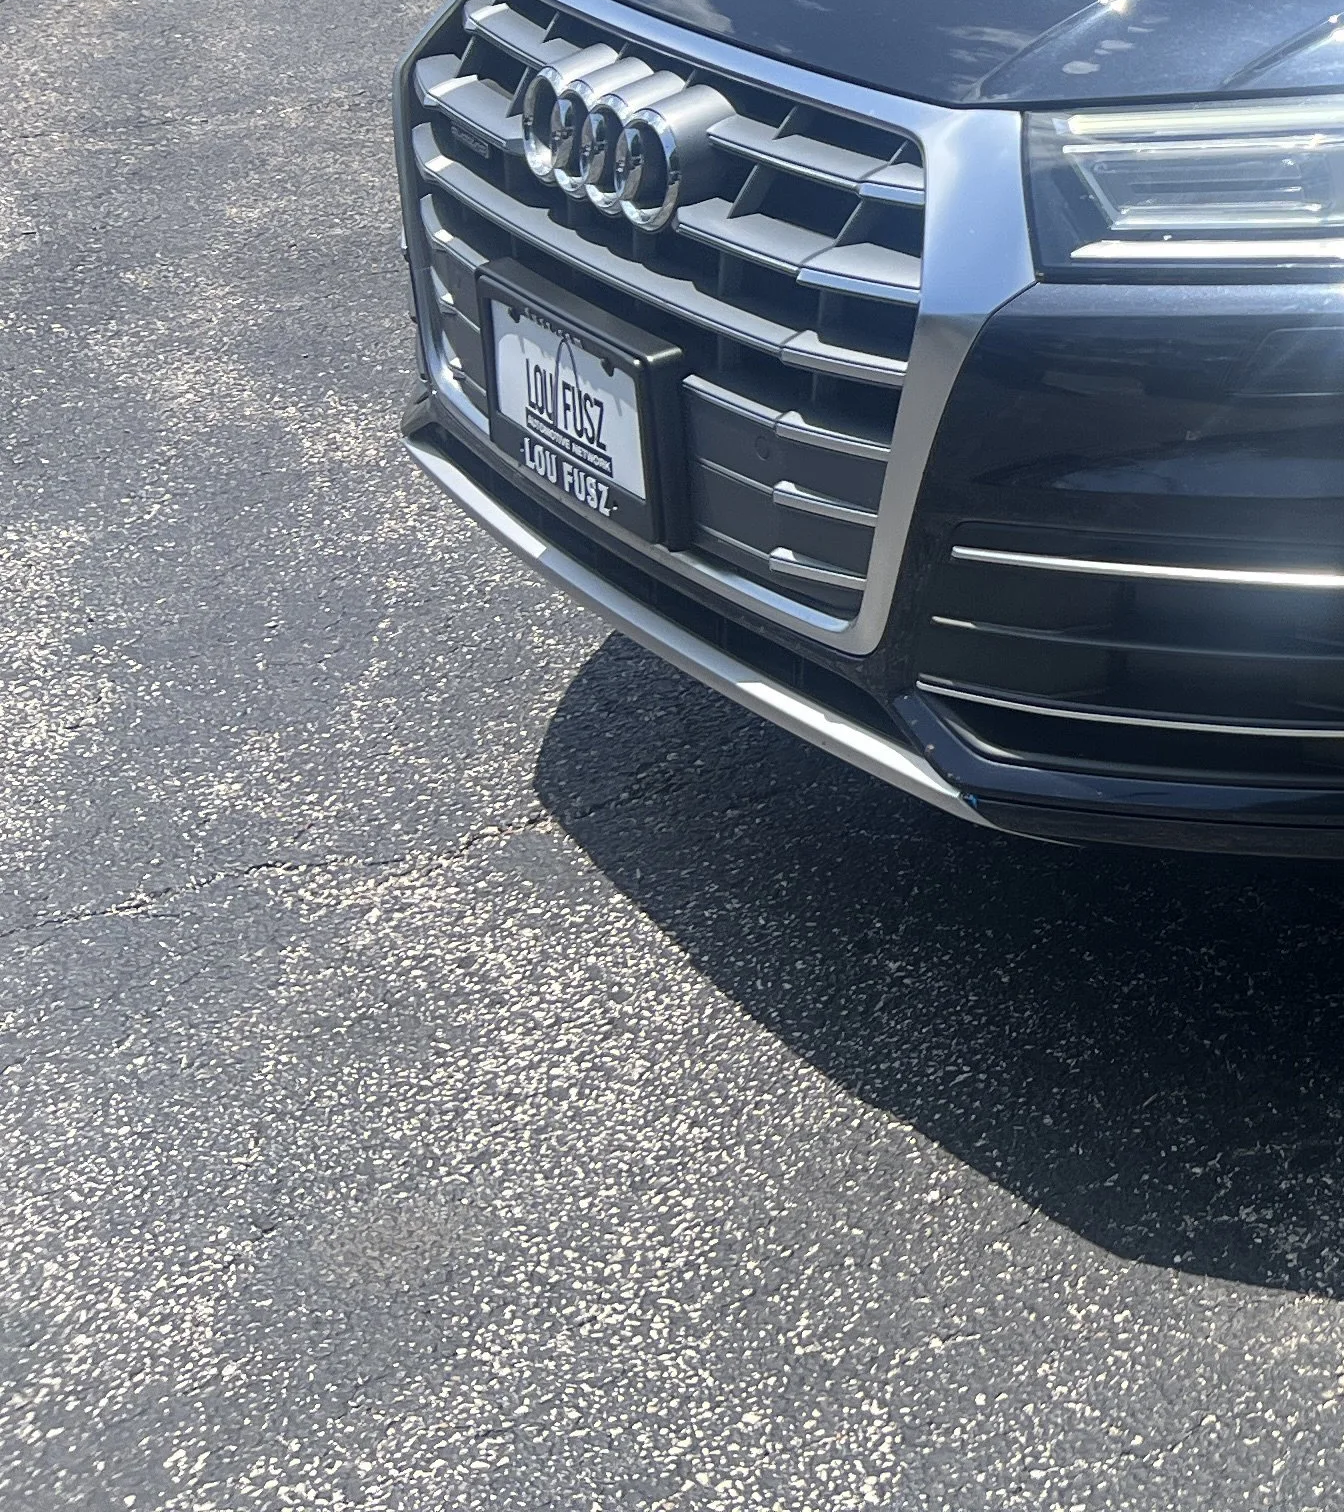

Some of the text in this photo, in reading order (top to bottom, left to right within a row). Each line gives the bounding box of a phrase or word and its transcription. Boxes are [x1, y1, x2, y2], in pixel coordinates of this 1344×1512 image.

[525, 357, 607, 451] LOU FUSZ
[523, 436, 611, 517] LOU FUSZ
